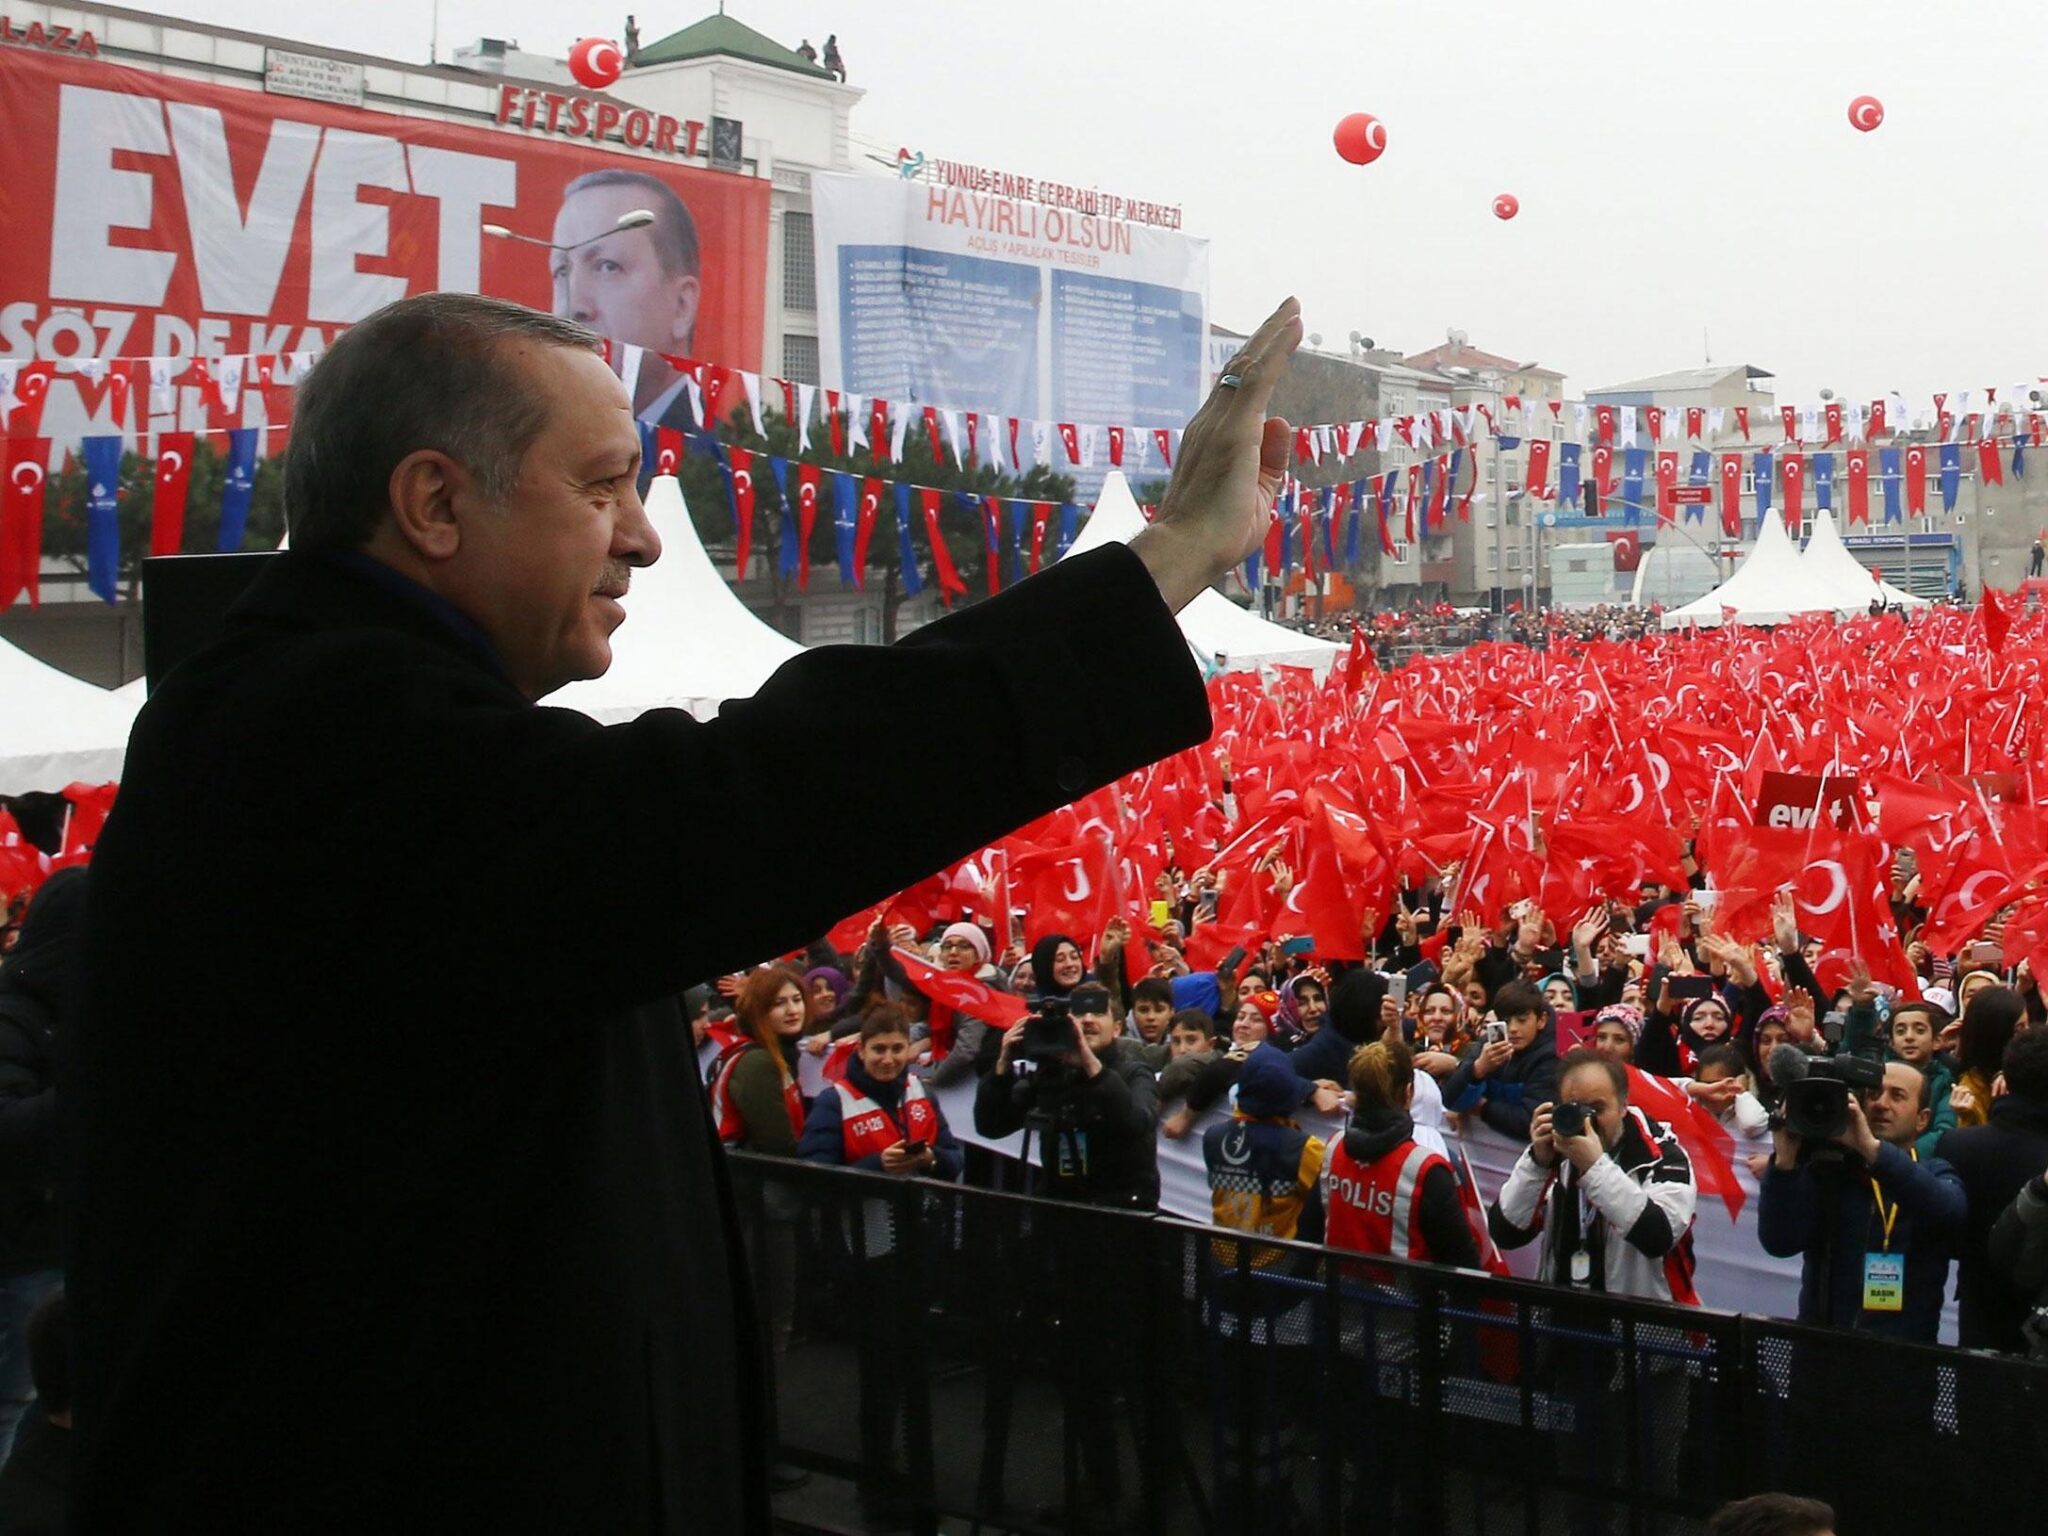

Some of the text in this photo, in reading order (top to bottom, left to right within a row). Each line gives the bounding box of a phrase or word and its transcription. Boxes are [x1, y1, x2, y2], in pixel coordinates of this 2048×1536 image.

[48, 84, 517, 323] EVET
[927, 186, 1132, 255] HAYIRLI OLSUN
[991, 171, 1034, 201] EMRE
[0, 302, 137, 375] SÖZ
[153, 314, 232, 383] DE
[1328, 1174, 1392, 1216] POLİS
